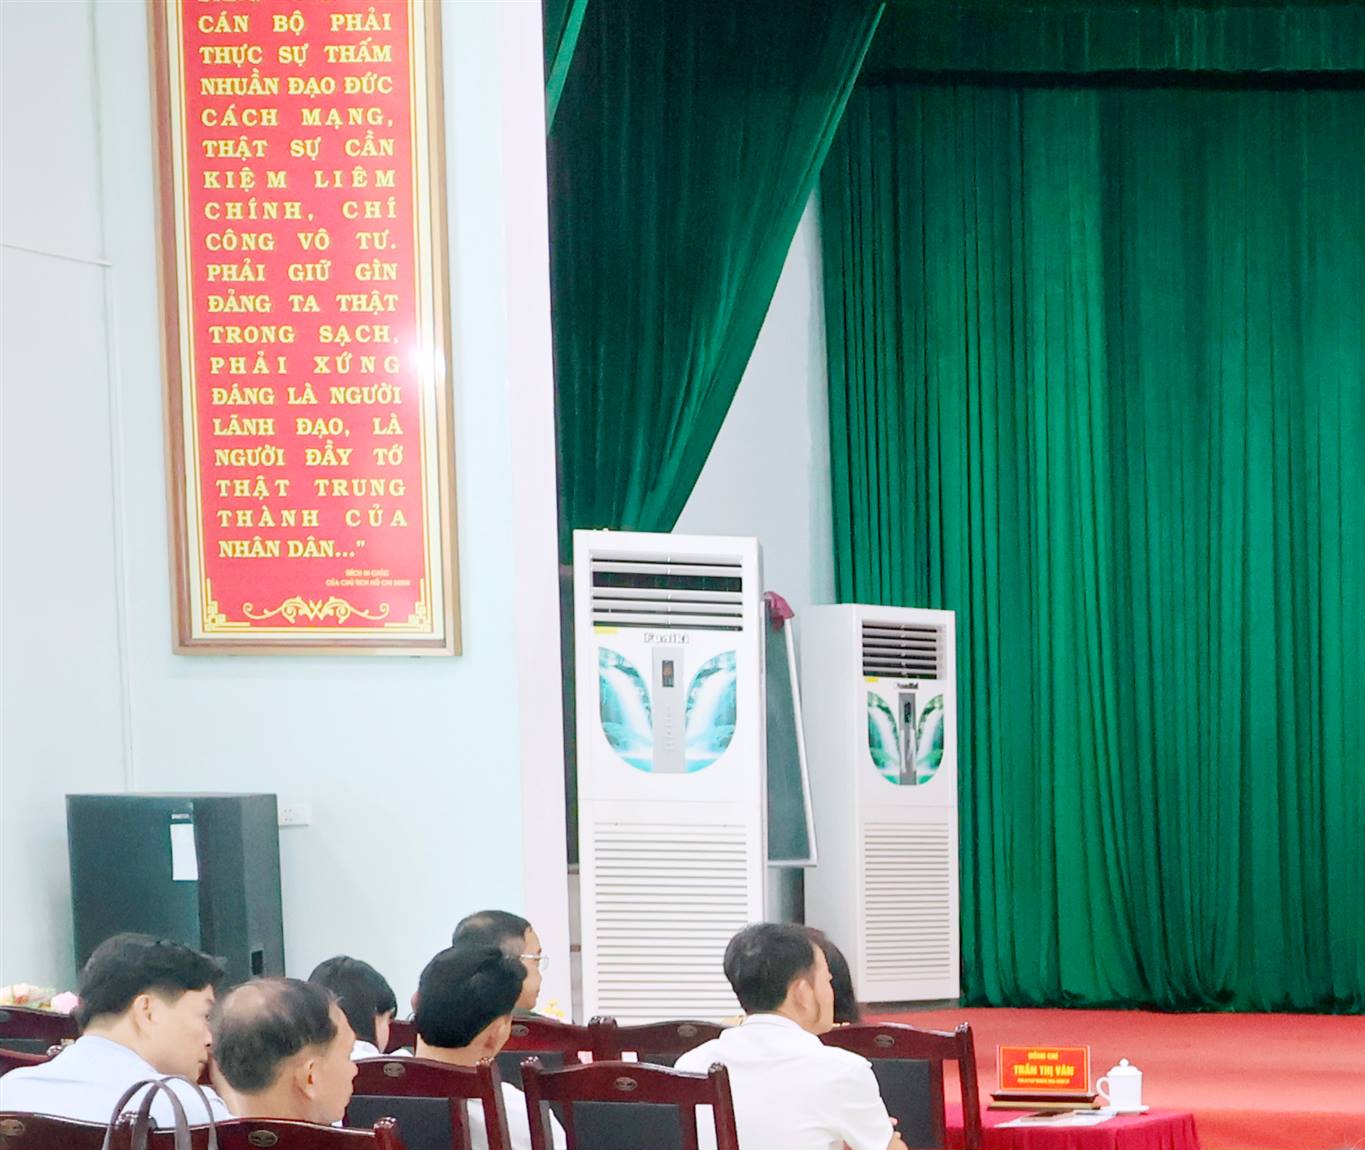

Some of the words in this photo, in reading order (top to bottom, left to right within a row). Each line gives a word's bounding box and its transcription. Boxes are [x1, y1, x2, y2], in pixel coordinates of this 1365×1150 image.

[198, 11, 249, 33] CÁN
[273, 10, 305, 36] BỘ
[330, 6, 392, 32] PHẢI
[199, 43, 263, 68] THỰC
[278, 43, 309, 67] SỰ
[324, 37, 393, 63] THẤM
[200, 68, 279, 96] NHUẦN
[288, 77, 336, 98] ĐẠO
[344, 72, 393, 94] ĐỨC
[202, 104, 278, 127] CÁCH
[302, 107, 393, 130] MẠNG,
[202, 136, 268, 161] THẬT
[290, 136, 321, 161] SỰ
[345, 129, 394, 157] CẦN
[203, 167, 288, 192] KIỆM
[315, 165, 396, 188] LIÊM
[205, 197, 314, 221] CHÍNH,
[343, 196, 397, 219] CHÍ
[206, 228, 275, 251] CÔNG
[297, 228, 330, 250] VÔ
[207, 258, 266, 282] PHẢI
[288, 259, 332, 281] GIỮ
[355, 258, 398, 281] GÌN
[208, 288, 272, 313] ĐẢNG
[288, 295, 320, 312] TA
[336, 289, 399, 316] THẬT
[209, 326, 295, 343] TRONG
[210, 350, 287, 374] PHẢI
[313, 352, 401, 374] XỨNG
[212, 383, 275, 405] ĐÁNG
[288, 382, 318, 405] LÀ
[330, 383, 403, 405] NGƯỜI
[213, 414, 275, 436] LÃNH
[296, 417, 350, 439] ĐẠO,
[373, 412, 403, 435] LÀ
[214, 444, 286, 466] NGƯỜI
[305, 439, 353, 466] ĐẦY
[373, 443, 404, 466] TỚ
[216, 475, 290, 500] THẬT
[314, 479, 406, 497] TRUNG
[217, 505, 319, 527] THÀNH
[345, 503, 408, 527] CỦA
[218, 536, 281, 558] NHÂN
